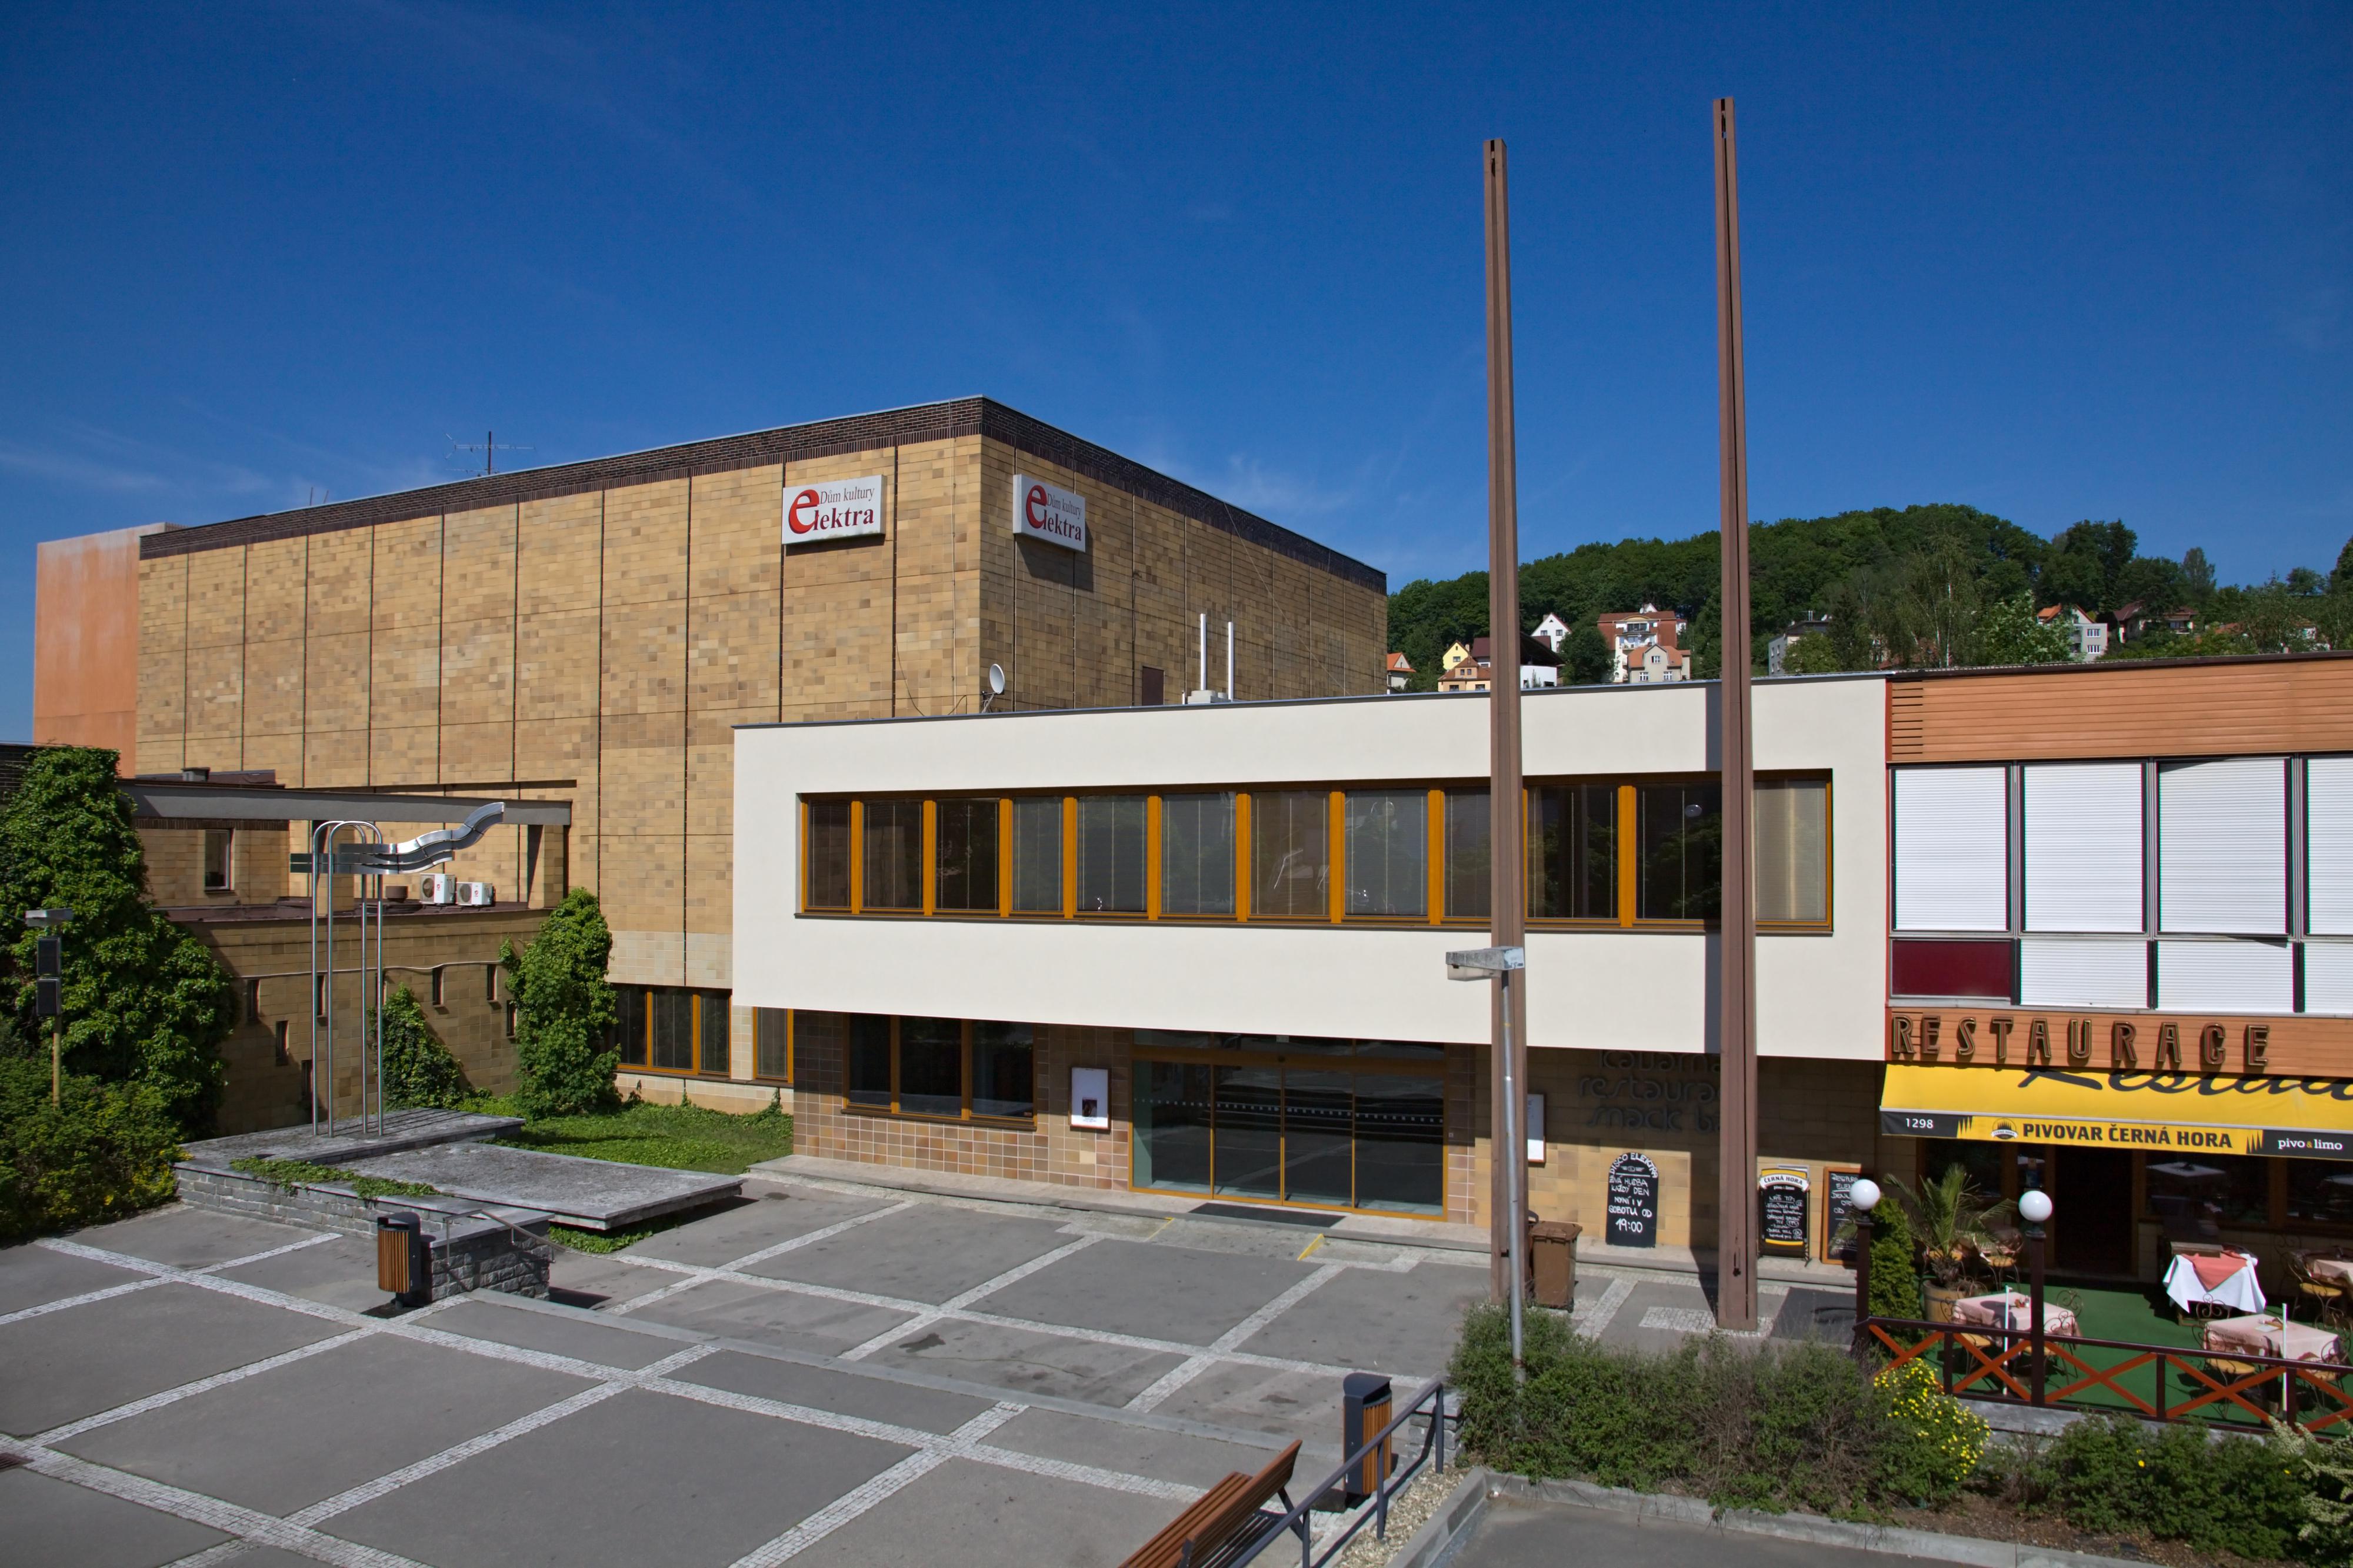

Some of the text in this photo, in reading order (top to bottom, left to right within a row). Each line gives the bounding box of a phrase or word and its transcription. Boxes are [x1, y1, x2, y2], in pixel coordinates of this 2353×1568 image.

[820, 486, 875, 504] Dům kultury
[1062, 499, 1082, 520] kultury
[1892, 1016, 2269, 1066] RESTAURACE
[1579, 1074, 1720, 1103] restaura
[1906, 1118, 1933, 1129] 1298
[2022, 1123, 2233, 1148] PIVOVAR ČERNÁ HORA
[2278, 1138, 2305, 1149] pivo
[2314, 1139, 2343, 1150] limo
[1609, 1153, 1658, 1178] DISCO ELEKTRA
[1624, 1178, 1648, 1187] HUDBA
[1764, 1175, 1803, 1185] ČERNÁ HORA
[1634, 1187, 1649, 1196] DEN
[1608, 1205, 1652, 1218] SOBOTU OD
[1615, 1218, 1642, 1233] 19:00
